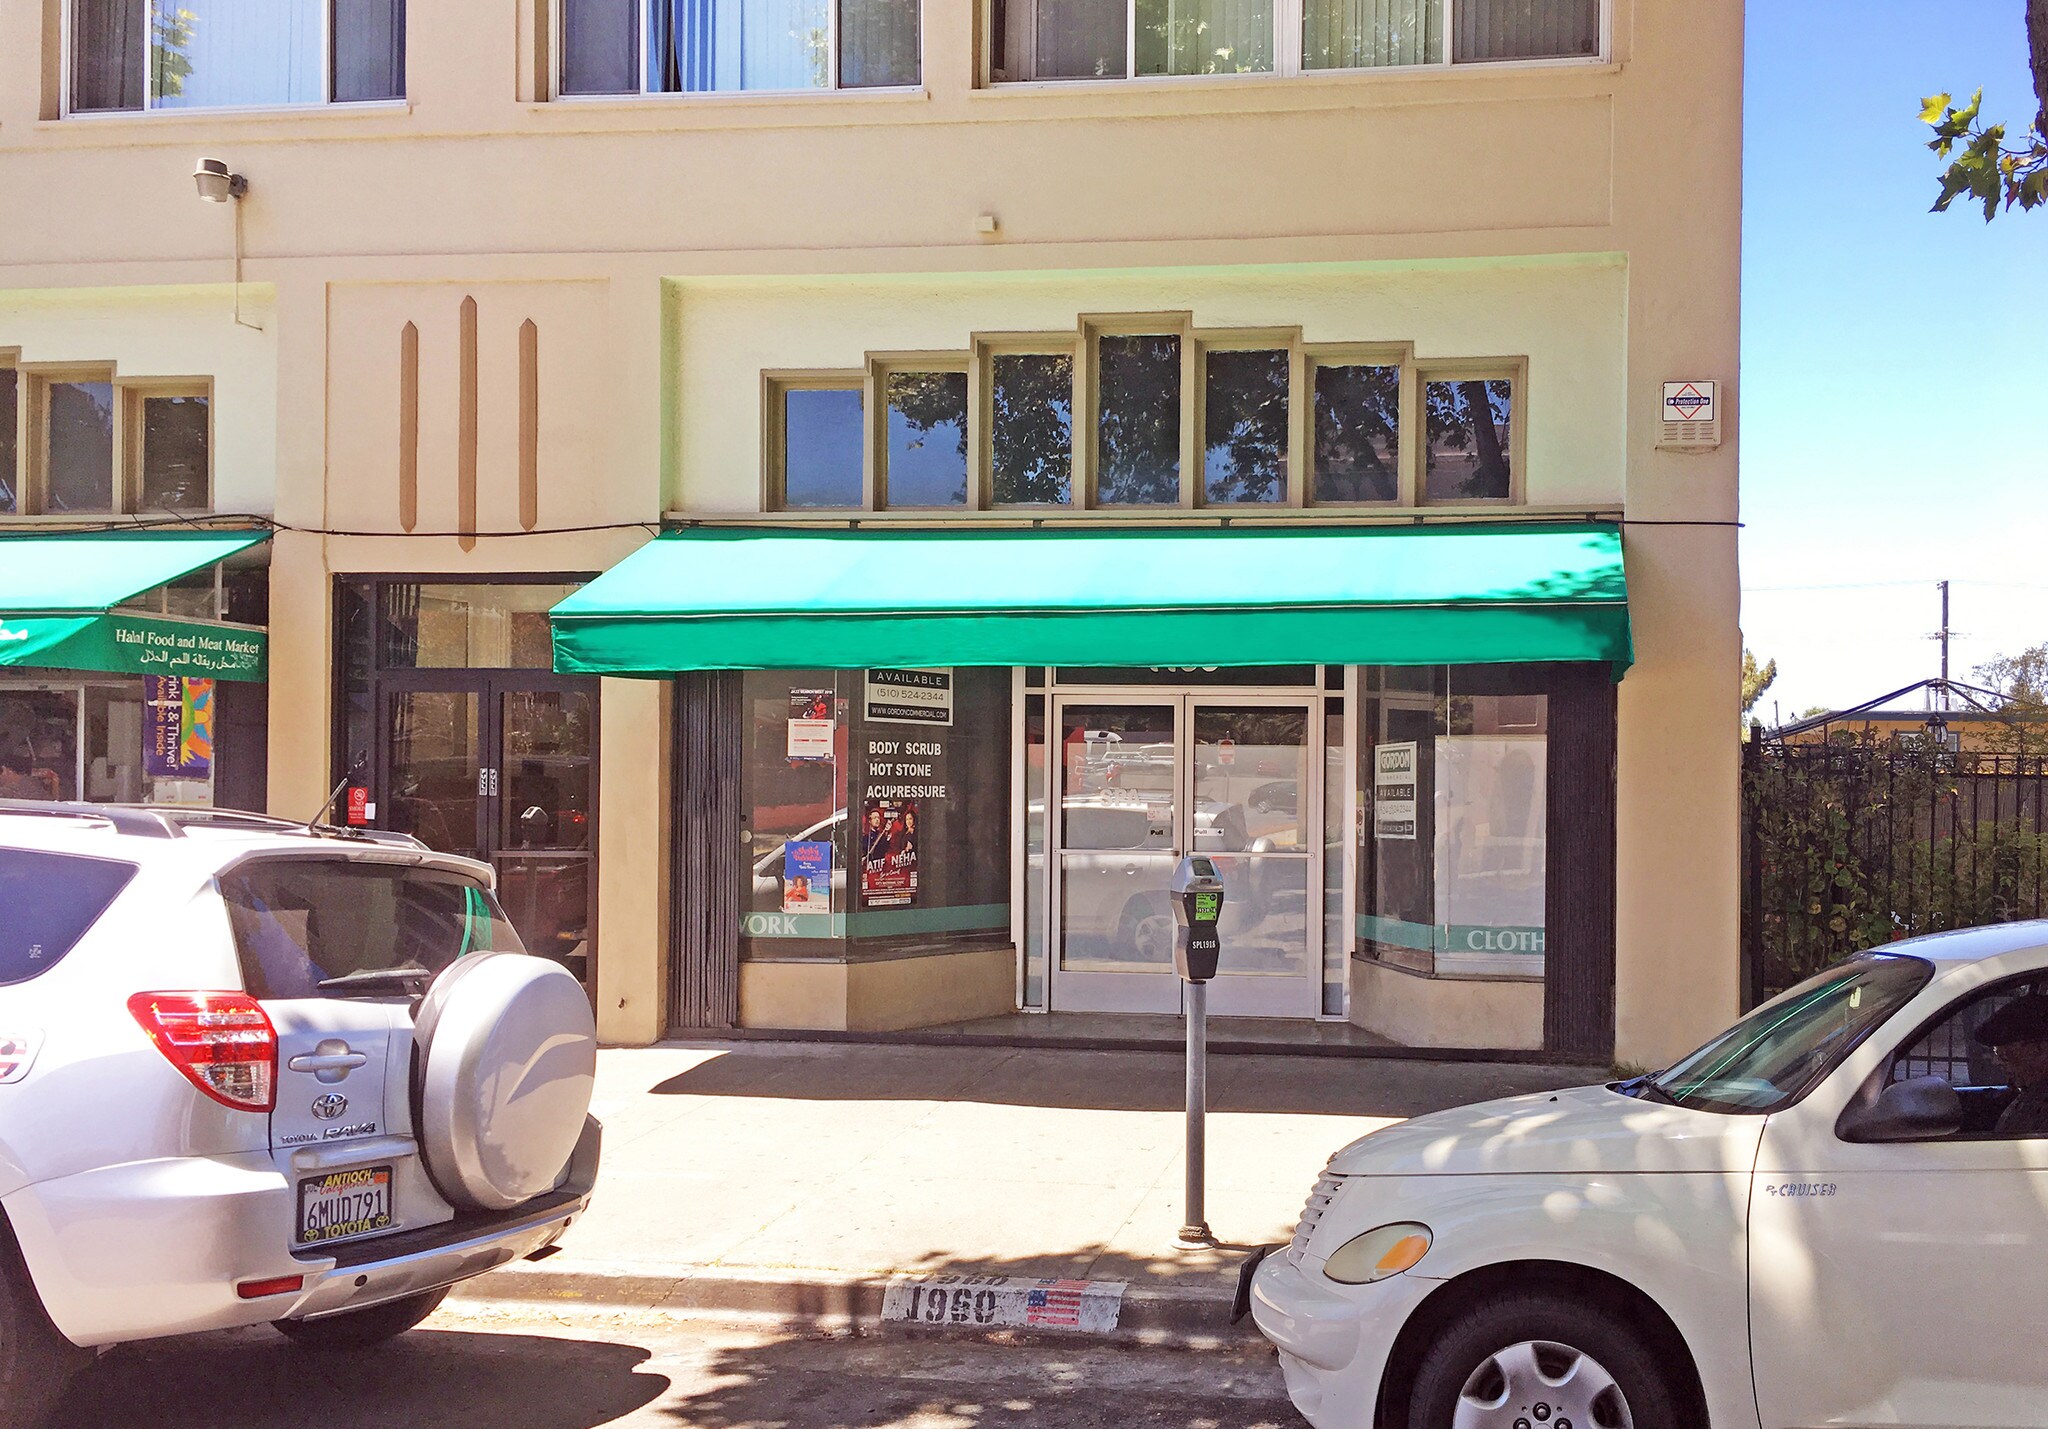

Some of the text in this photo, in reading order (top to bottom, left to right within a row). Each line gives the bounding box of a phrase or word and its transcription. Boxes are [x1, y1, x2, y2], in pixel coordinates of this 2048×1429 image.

[116, 629, 259, 654] Halal Food and Meat Market
[168, 675, 180, 699] rink
[877, 672, 942, 686] AVAILABLE
[877, 688, 900, 698] (510)
[155, 674, 166, 756] Availble Inside
[167, 711, 179, 722] &
[166, 723, 180, 768] Thrive!
[869, 741, 942, 756] BODY SCRUB
[869, 763, 932, 777] HOT STONE
[1380, 751, 1410, 770] GORDON
[866, 785, 946, 798] ACUPRESSURE
[1100, 788, 1141, 807] SPA
[1380, 789, 1412, 798] AVAILABLE
[867, 852, 917, 871] ATIF NEHA
[1467, 929, 1545, 952] CLOTH
[281, 1122, 377, 1144] TOYOTA RAV4
[324, 1169, 373, 1187] ANTIOCH
[1779, 1183, 1837, 1196] CRUISER
[307, 1189, 385, 1230] 6MUD791
[323, 1218, 371, 1239] TOYOTA
